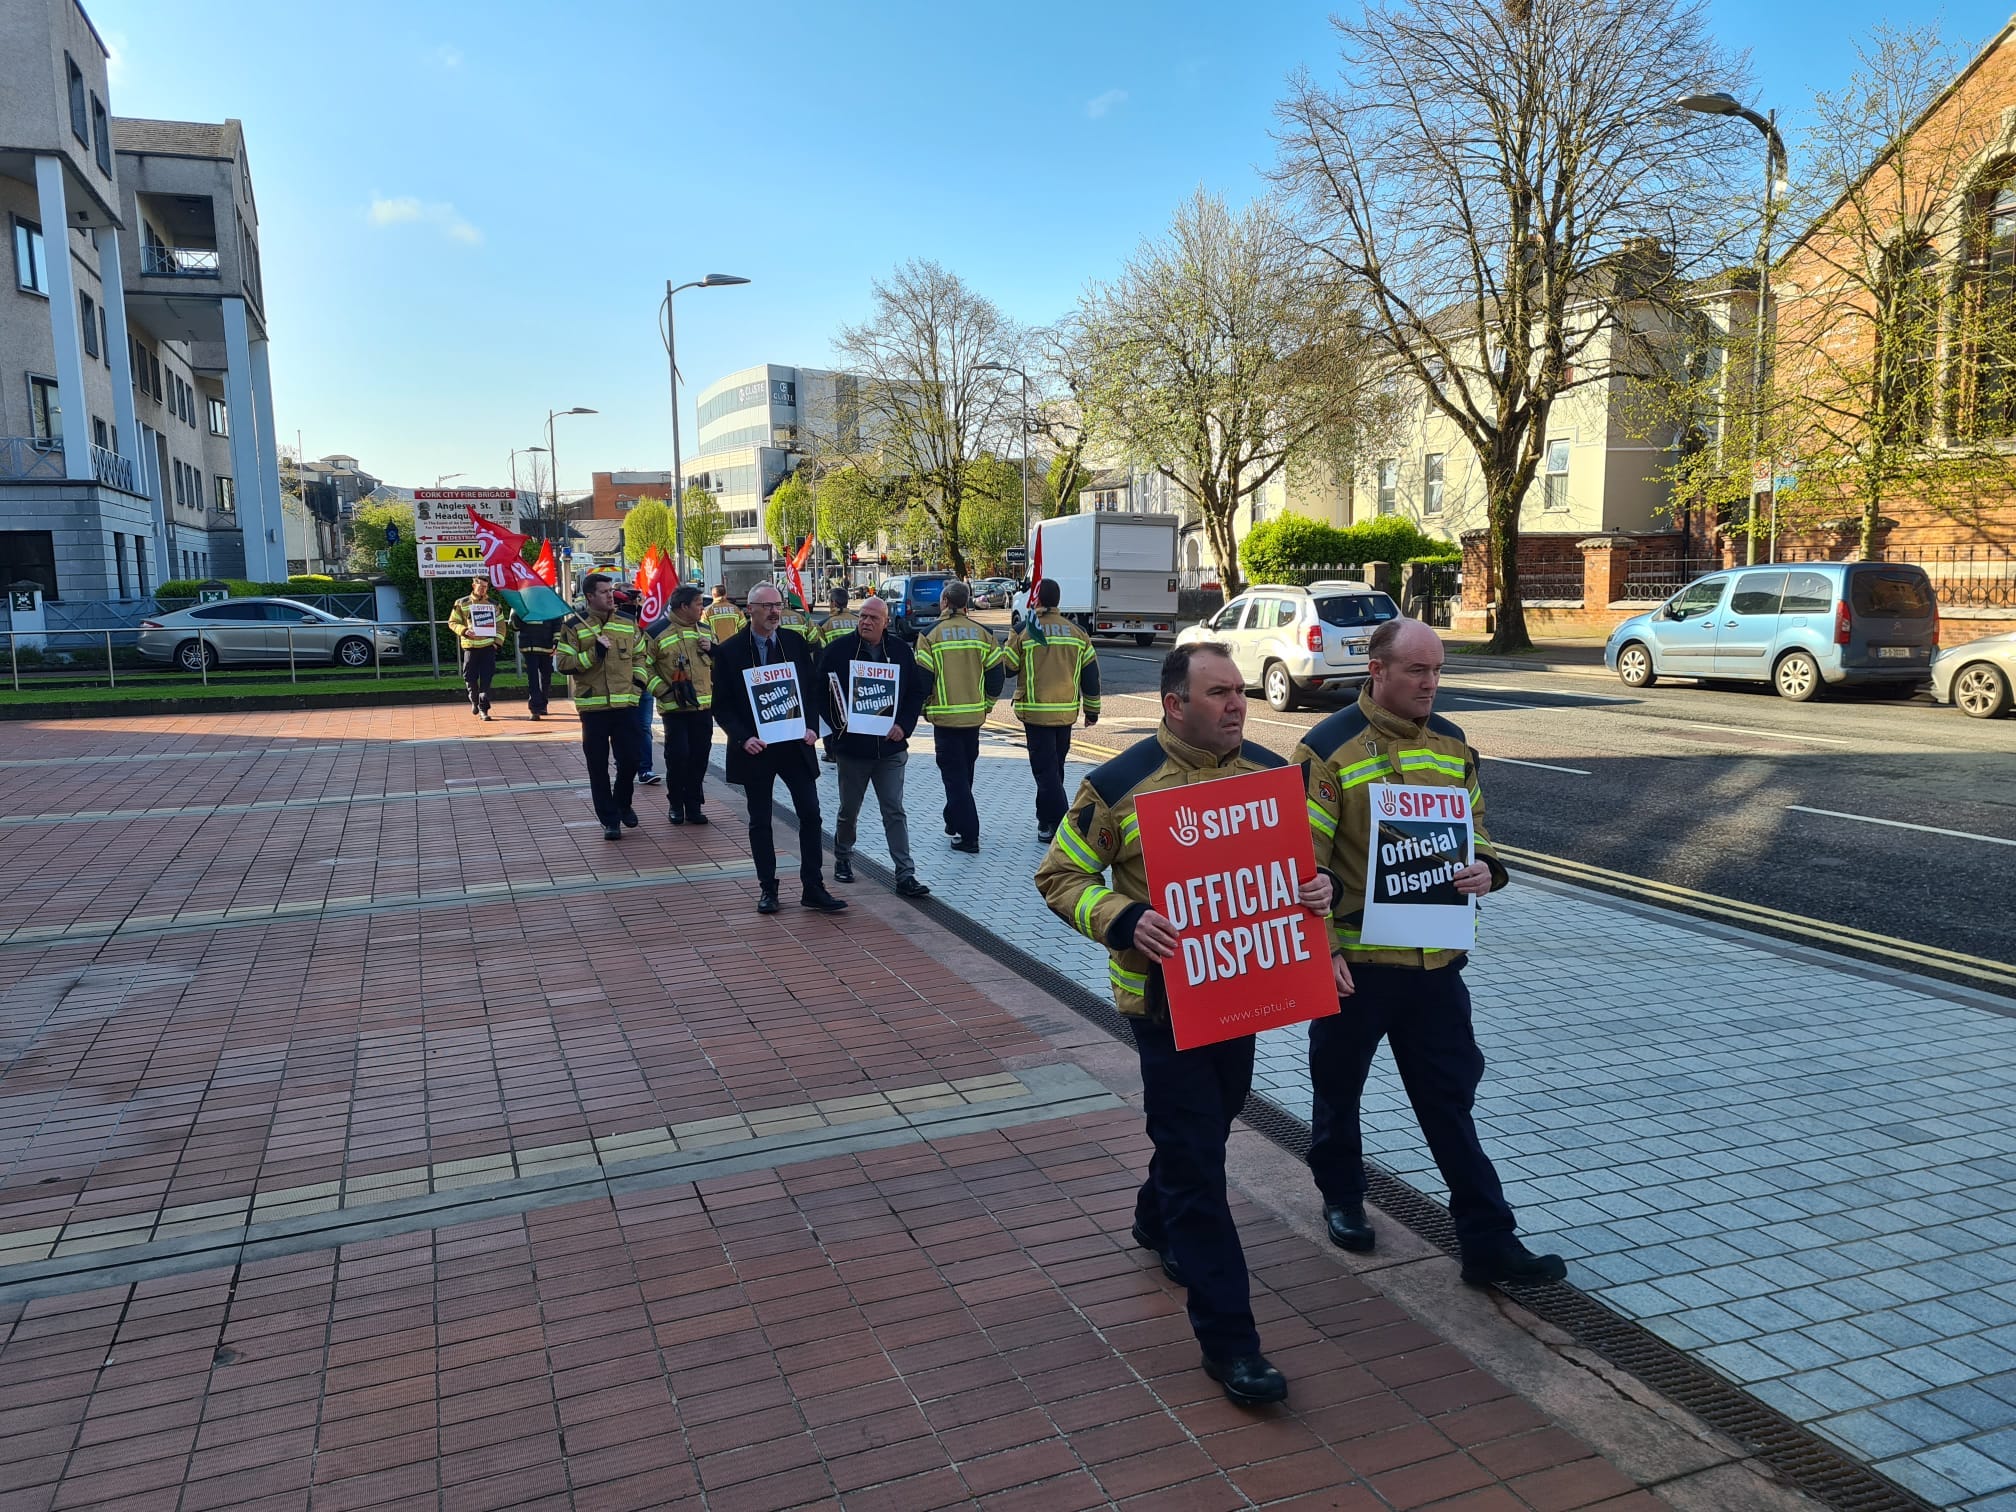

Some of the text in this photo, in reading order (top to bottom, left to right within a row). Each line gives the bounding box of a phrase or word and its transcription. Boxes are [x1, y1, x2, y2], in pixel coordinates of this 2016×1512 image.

[478, 490, 510, 498] BRIGADE
[437, 502, 491, 511] Anglesa St.
[435, 512, 494, 521] Headquters
[454, 548, 484, 558] AIR
[713, 607, 735, 615] FIRE
[782, 615, 798, 625] RE
[941, 627, 979, 640] FIRE
[763, 668, 792, 682] SIPTU
[867, 666, 894, 679] SIPTU
[759, 686, 788, 705] Stailc
[857, 684, 886, 697] Stailc
[761, 696, 799, 720] Oifigiúil
[855, 695, 894, 711] Oifigiúil
[1398, 791, 1465, 819] SIPTU
[1202, 797, 1280, 839] SIPTU
[1381, 827, 1457, 867] Official
[1181, 913, 1310, 987] DISPUTE
[1219, 998, 1297, 1025] www.siptu.ie
